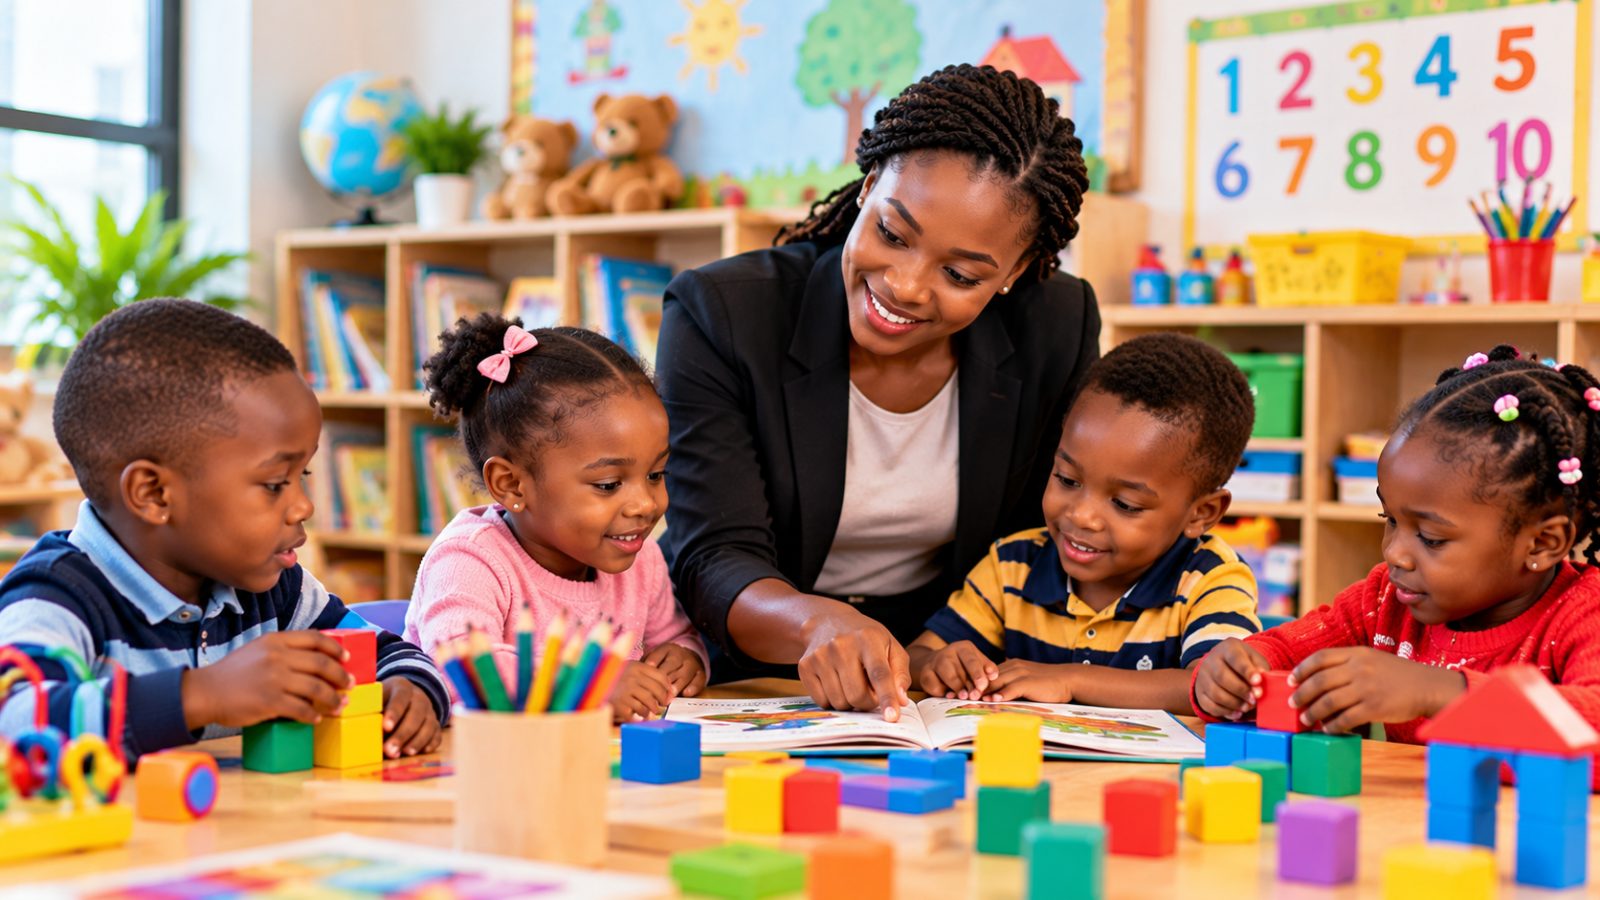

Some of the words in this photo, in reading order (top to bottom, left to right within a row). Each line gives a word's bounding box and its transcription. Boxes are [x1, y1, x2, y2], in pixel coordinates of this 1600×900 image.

[1218, 57, 1240, 115] 1
[1278, 50, 1314, 111] 2
[1345, 41, 1384, 105] 3
[1413, 34, 1458, 97] 4
[1493, 25, 1537, 92] 5
[1214, 141, 1250, 199] 6
[1277, 135, 1316, 196] 7
[1344, 131, 1383, 191] 8
[1415, 124, 1458, 189] 9
[1487, 118, 1553, 183] 10
